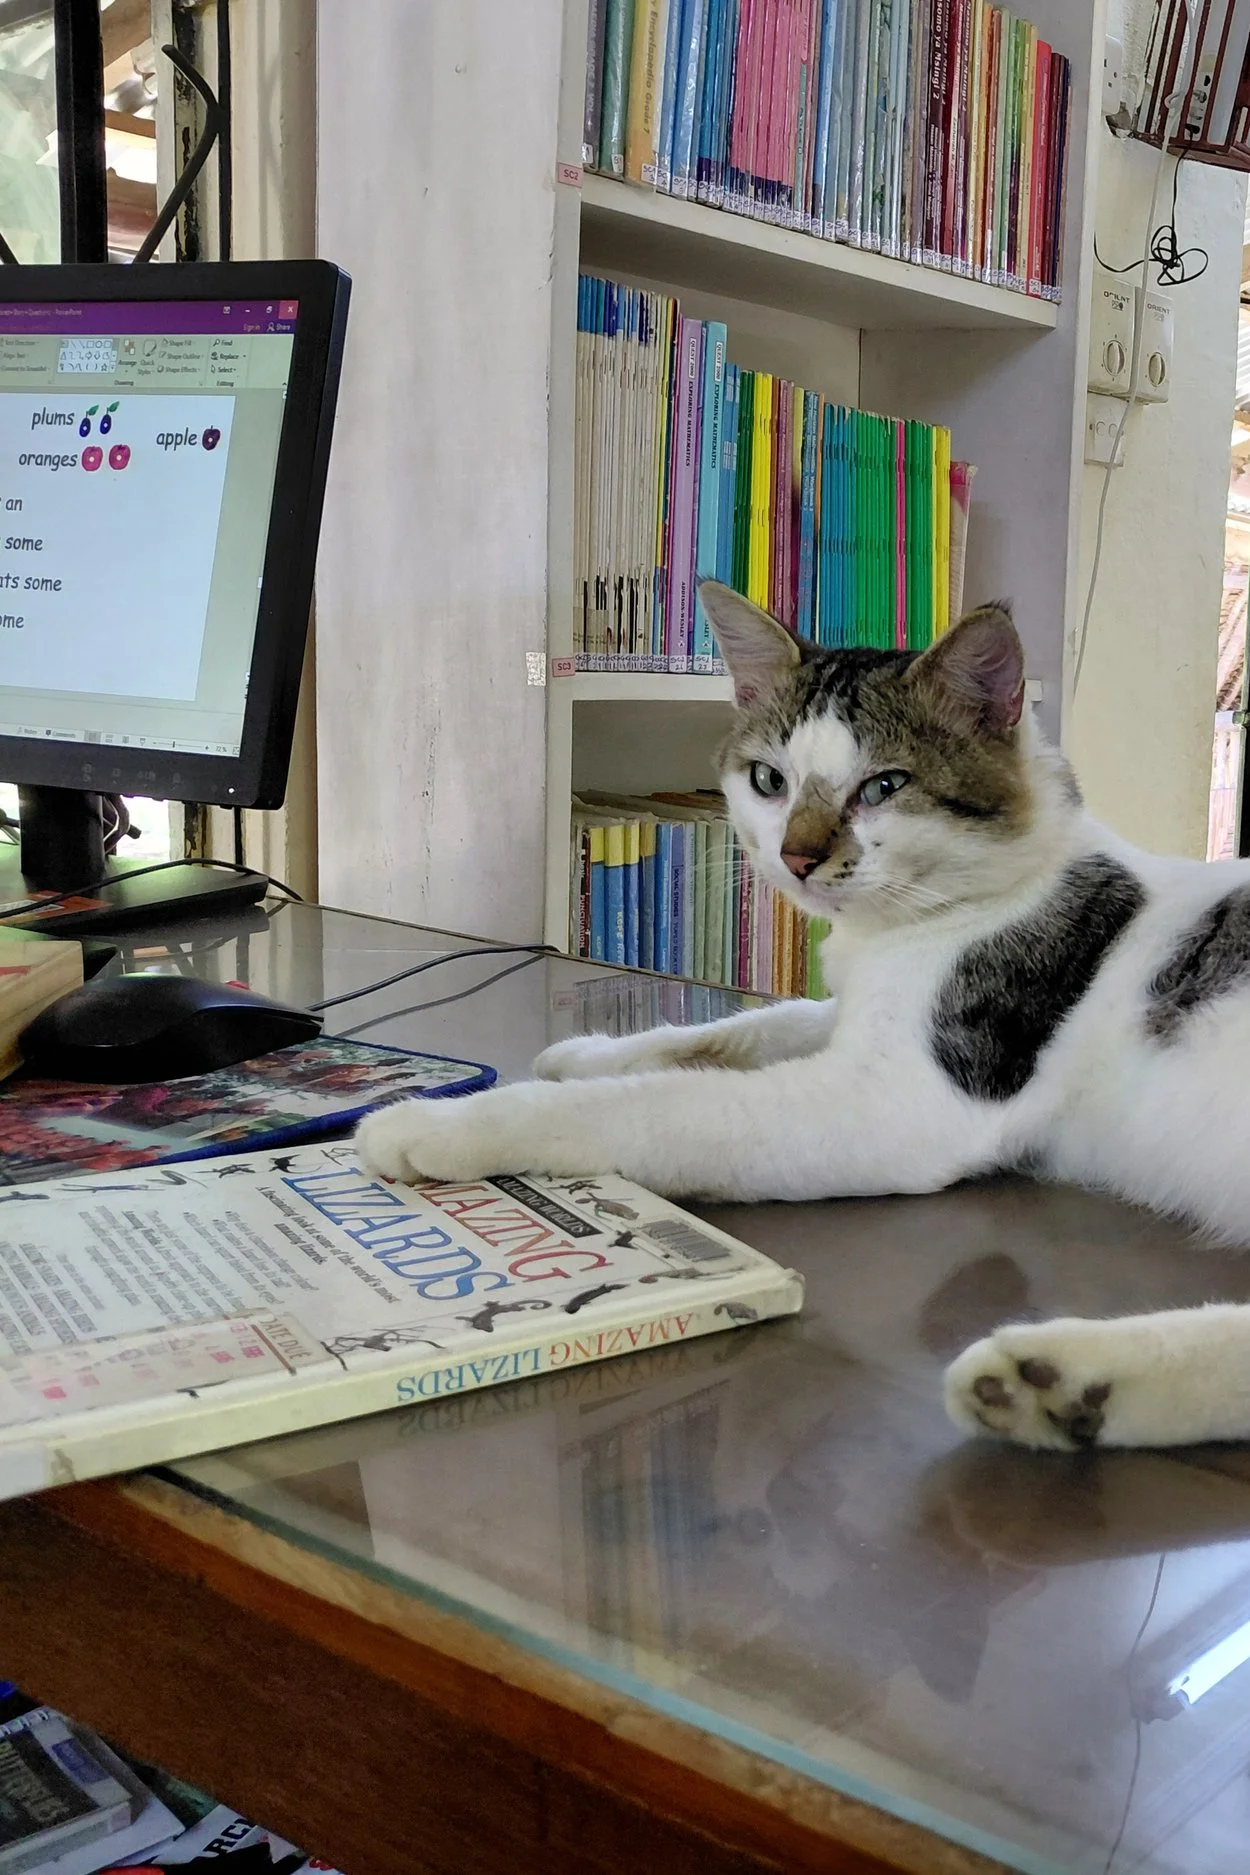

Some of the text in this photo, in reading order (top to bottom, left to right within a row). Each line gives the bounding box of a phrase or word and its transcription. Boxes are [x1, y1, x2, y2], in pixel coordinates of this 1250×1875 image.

[563, 169, 579, 181] SC2
[1147, 303, 1170, 315] ORIENT
[32, 407, 75, 430] plums
[156, 427, 198, 451] apple
[19, 452, 78, 471] oranges
[5, 498, 23, 511] an
[4, 537, 43, 551] some
[24, 576, 62, 591] some
[558, 663, 571, 671] SC3
[261, 1190, 299, 1217] fascinating
[291, 1216, 315, 1228] look
[312, 1234, 336, 1249] some
[337, 1254, 355, 1265] the
[350, 1265, 382, 1287] world's
[274, 1223, 306, 1245] amazing
[281, 1166, 516, 1300] LIZARDS
[400, 1178, 614, 1284] MAZING
[278, 1340, 313, 1359] DUE
[396, 1313, 694, 1402] AMAZING LIZARDS
